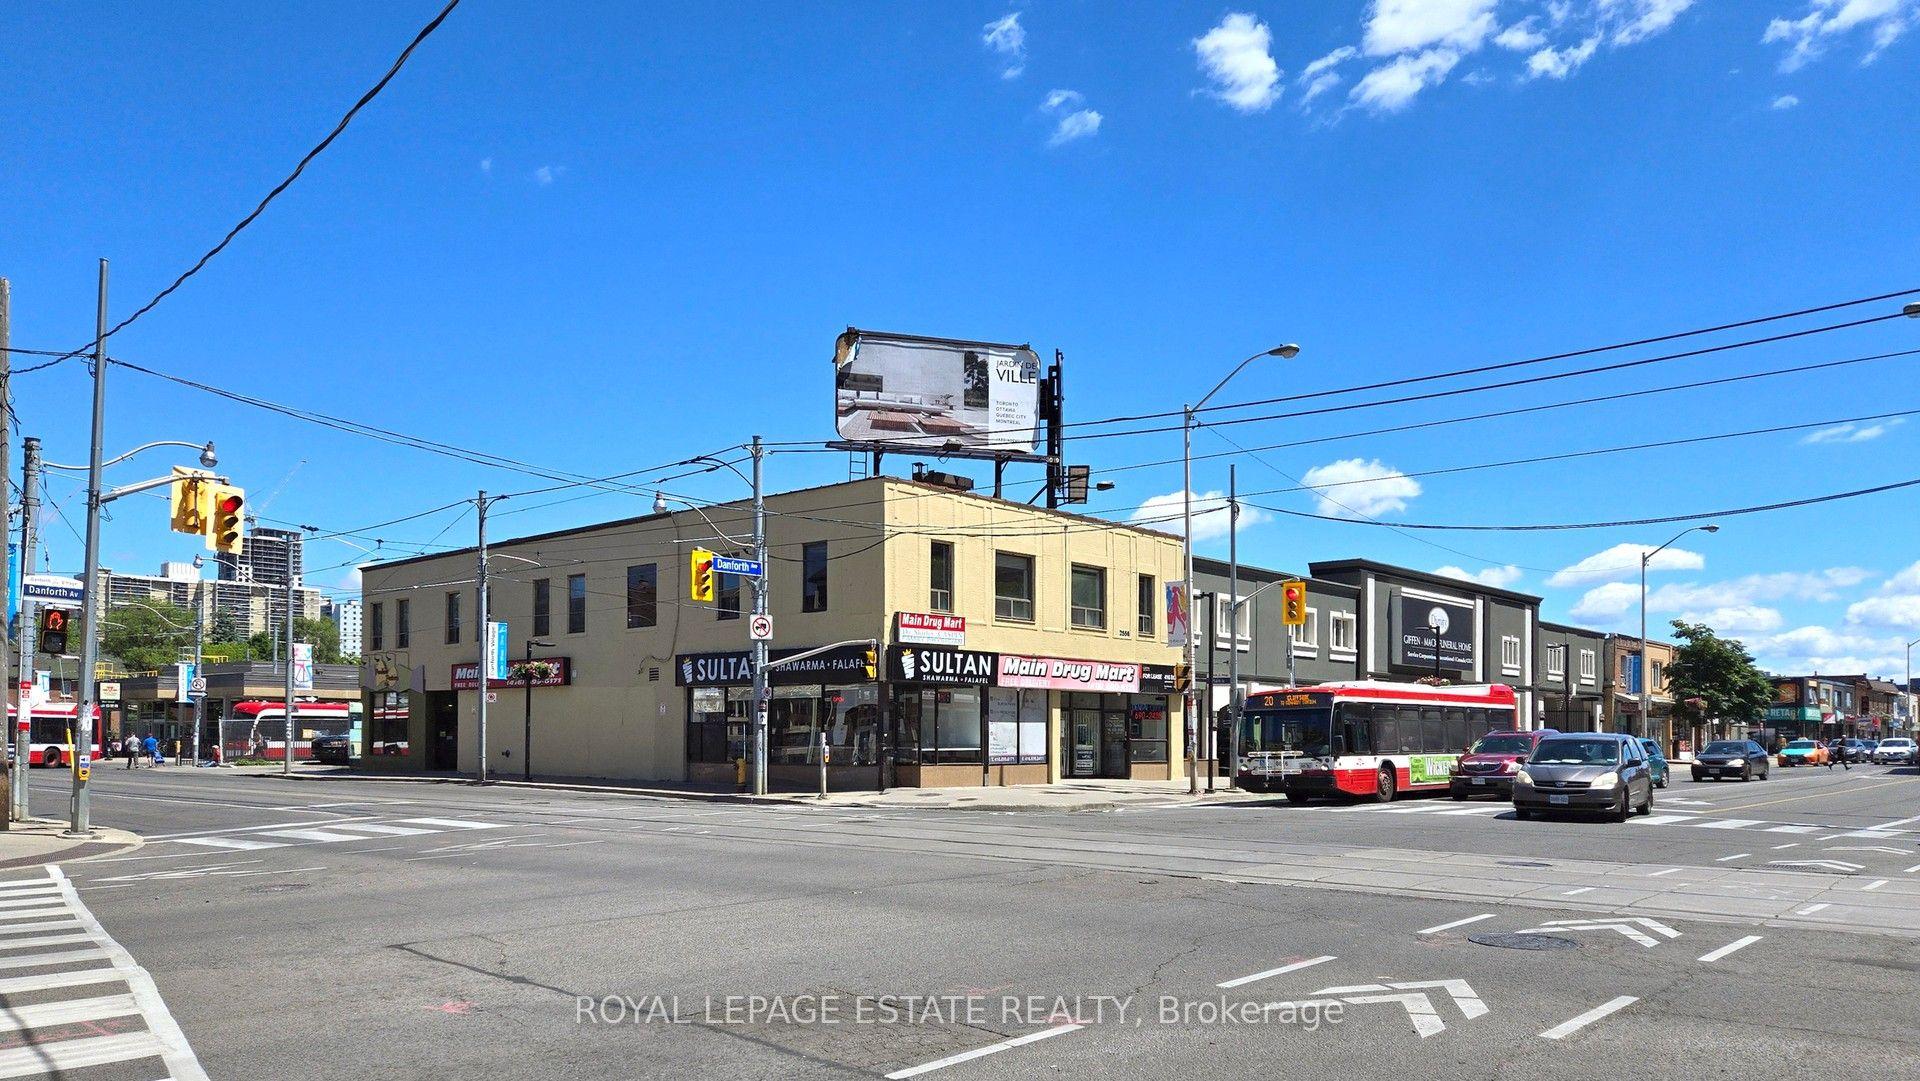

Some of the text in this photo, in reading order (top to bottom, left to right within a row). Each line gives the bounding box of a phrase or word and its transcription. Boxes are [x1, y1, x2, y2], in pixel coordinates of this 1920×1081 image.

[996, 369, 1036, 384] VILLE
[717, 559, 749, 571] Danforth
[29, 585, 67, 597] Danforth
[901, 613, 962, 629] Main Drug Mart
[1403, 634, 1421, 645] GIFFEN
[1423, 638, 1436, 648] MAC
[1458, 642, 1472, 652] HOME
[697, 657, 751, 681] SULTA
[777, 659, 864, 672] SHAWARMA FALAFE
[920, 650, 992, 676] SULTAN
[1003, 657, 1136, 682] Main Drug Mart
[455, 667, 481, 680] Mai
[922, 674, 959, 682] SHAWARMA
[1264, 696, 1274, 707] 20
